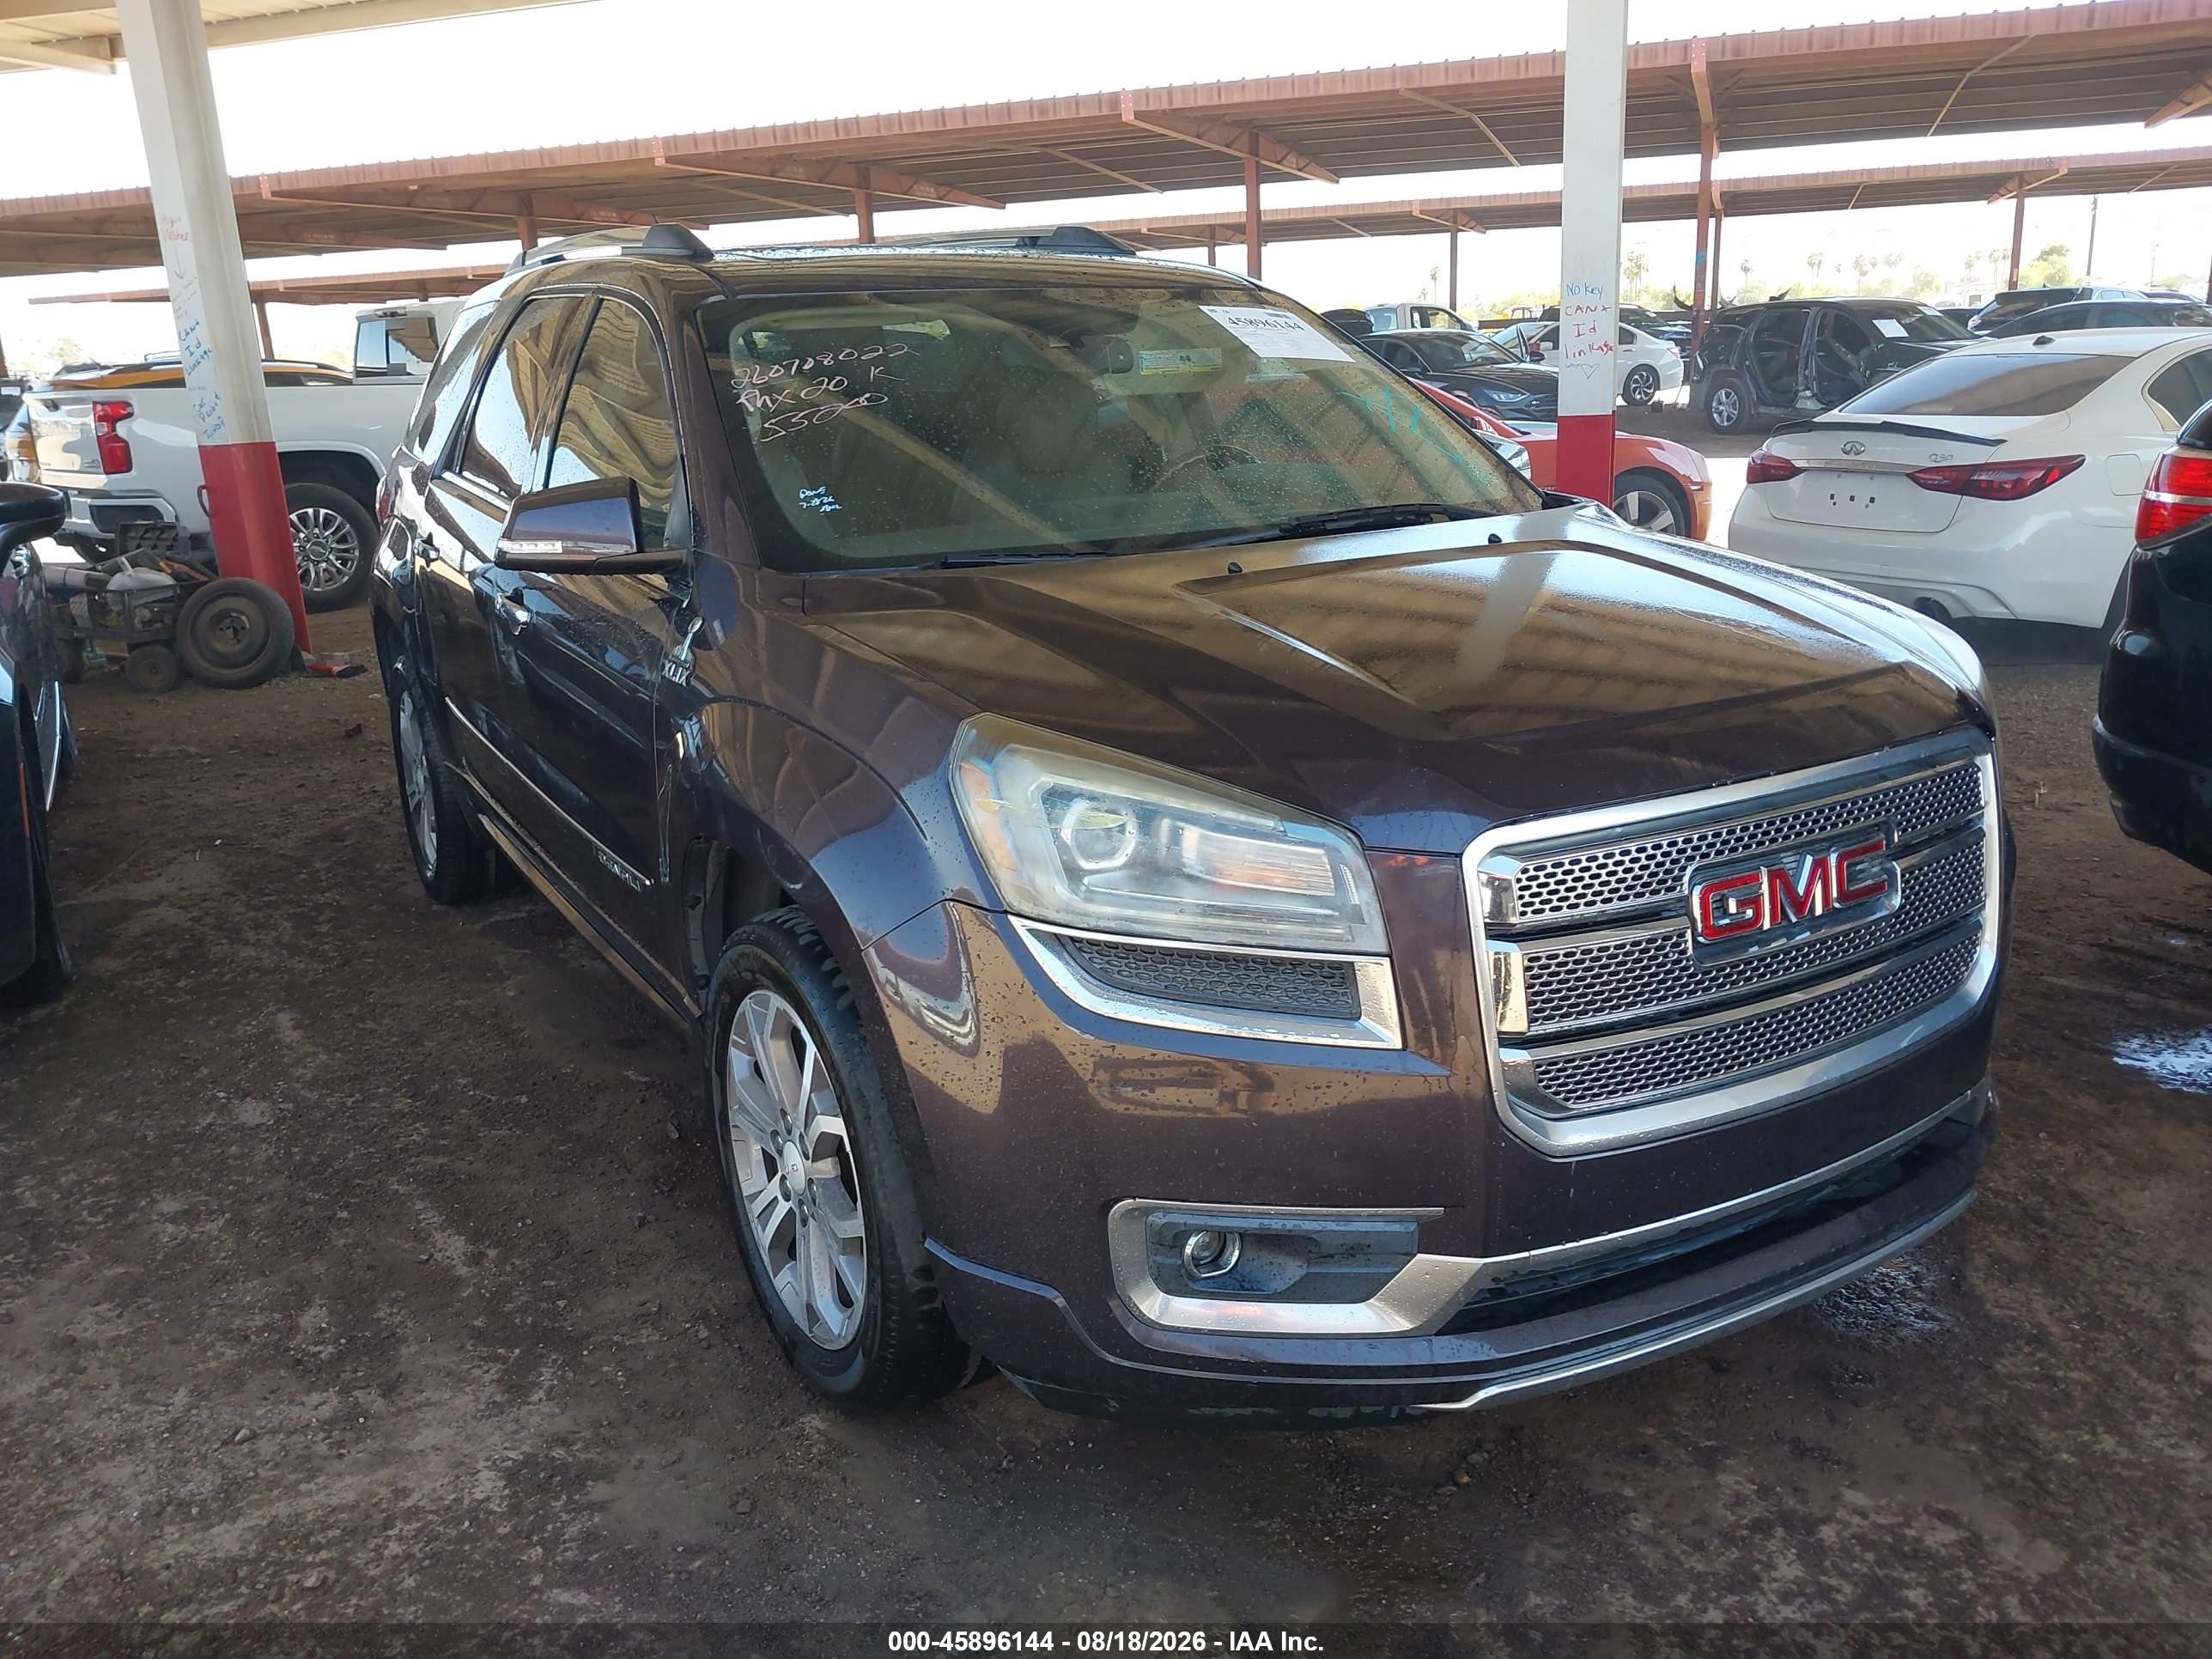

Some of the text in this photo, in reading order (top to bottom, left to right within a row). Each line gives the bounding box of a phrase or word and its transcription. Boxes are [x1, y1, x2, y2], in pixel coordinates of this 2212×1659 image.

[1566, 283, 1581, 296] No
[1228, 316, 1305, 331] 45896144
[732, 343, 921, 389] 260708022
[1692, 837, 1888, 945] GMC
